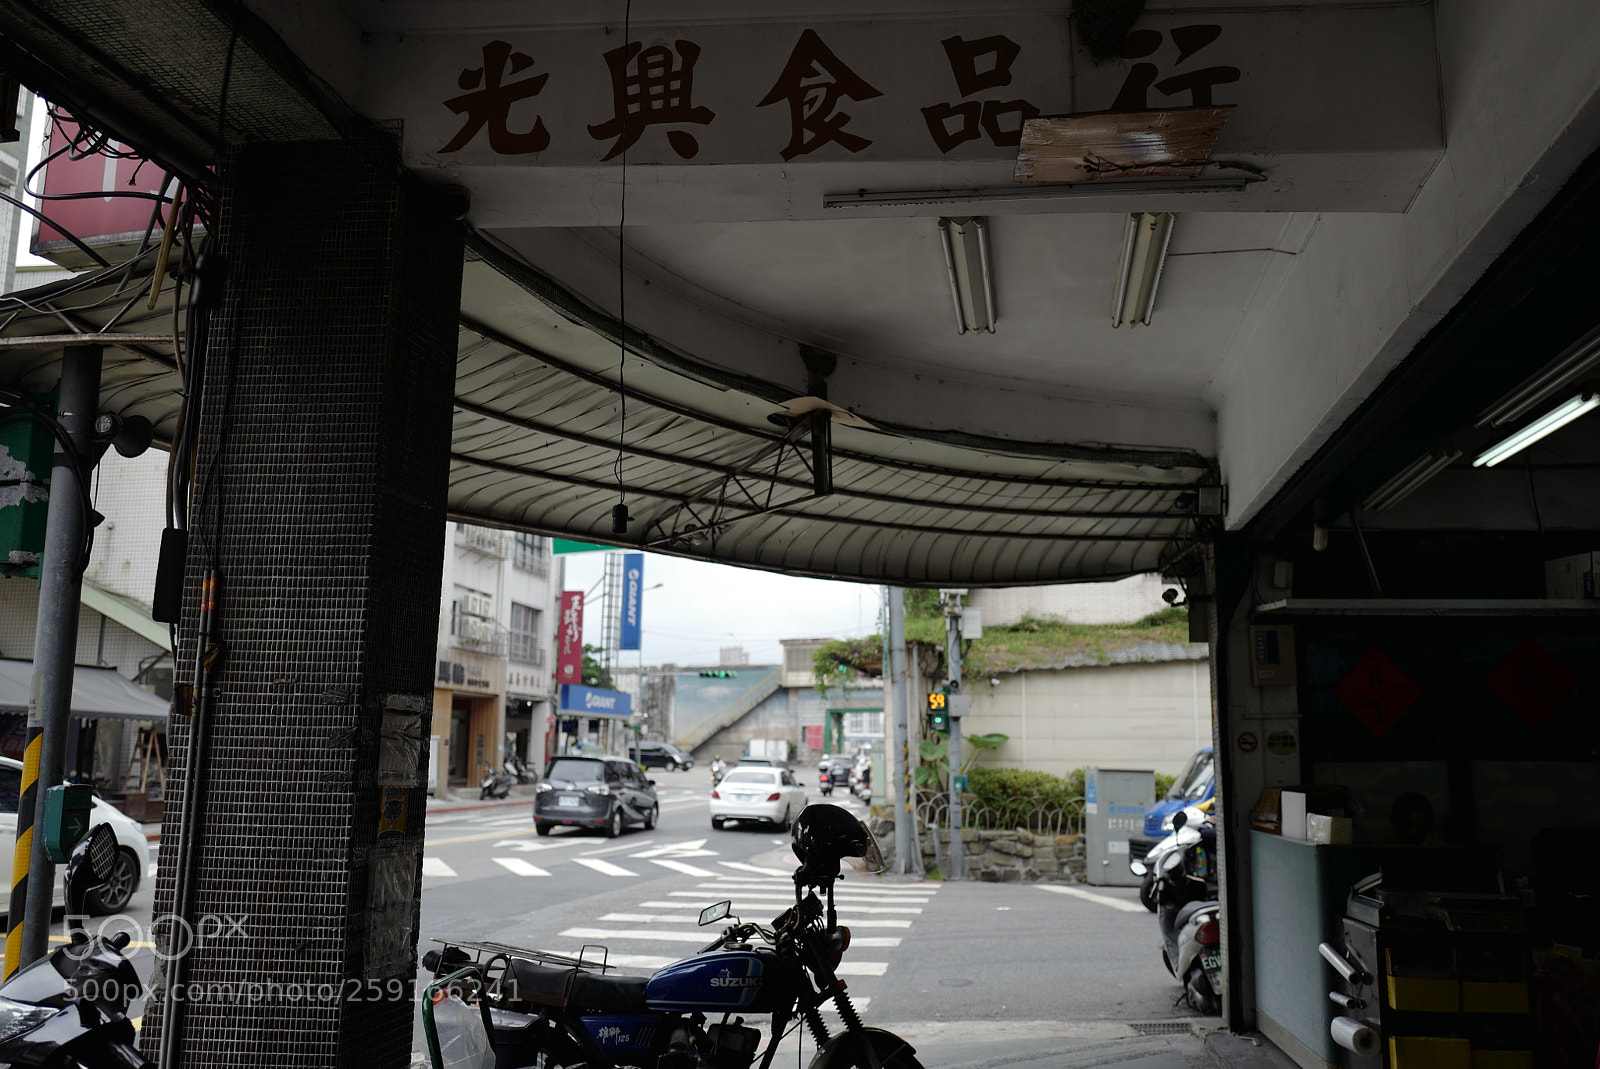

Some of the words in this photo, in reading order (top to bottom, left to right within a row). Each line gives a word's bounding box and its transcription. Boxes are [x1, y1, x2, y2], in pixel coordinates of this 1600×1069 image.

[437, 25, 1241, 162] 光興食品行
[627, 582, 638, 627] GIANT
[591, 696, 616, 710] GIANT
[929, 693, 945, 709] 59
[710, 977, 763, 987] SUZUKI
[618, 1034, 630, 1043] 125
